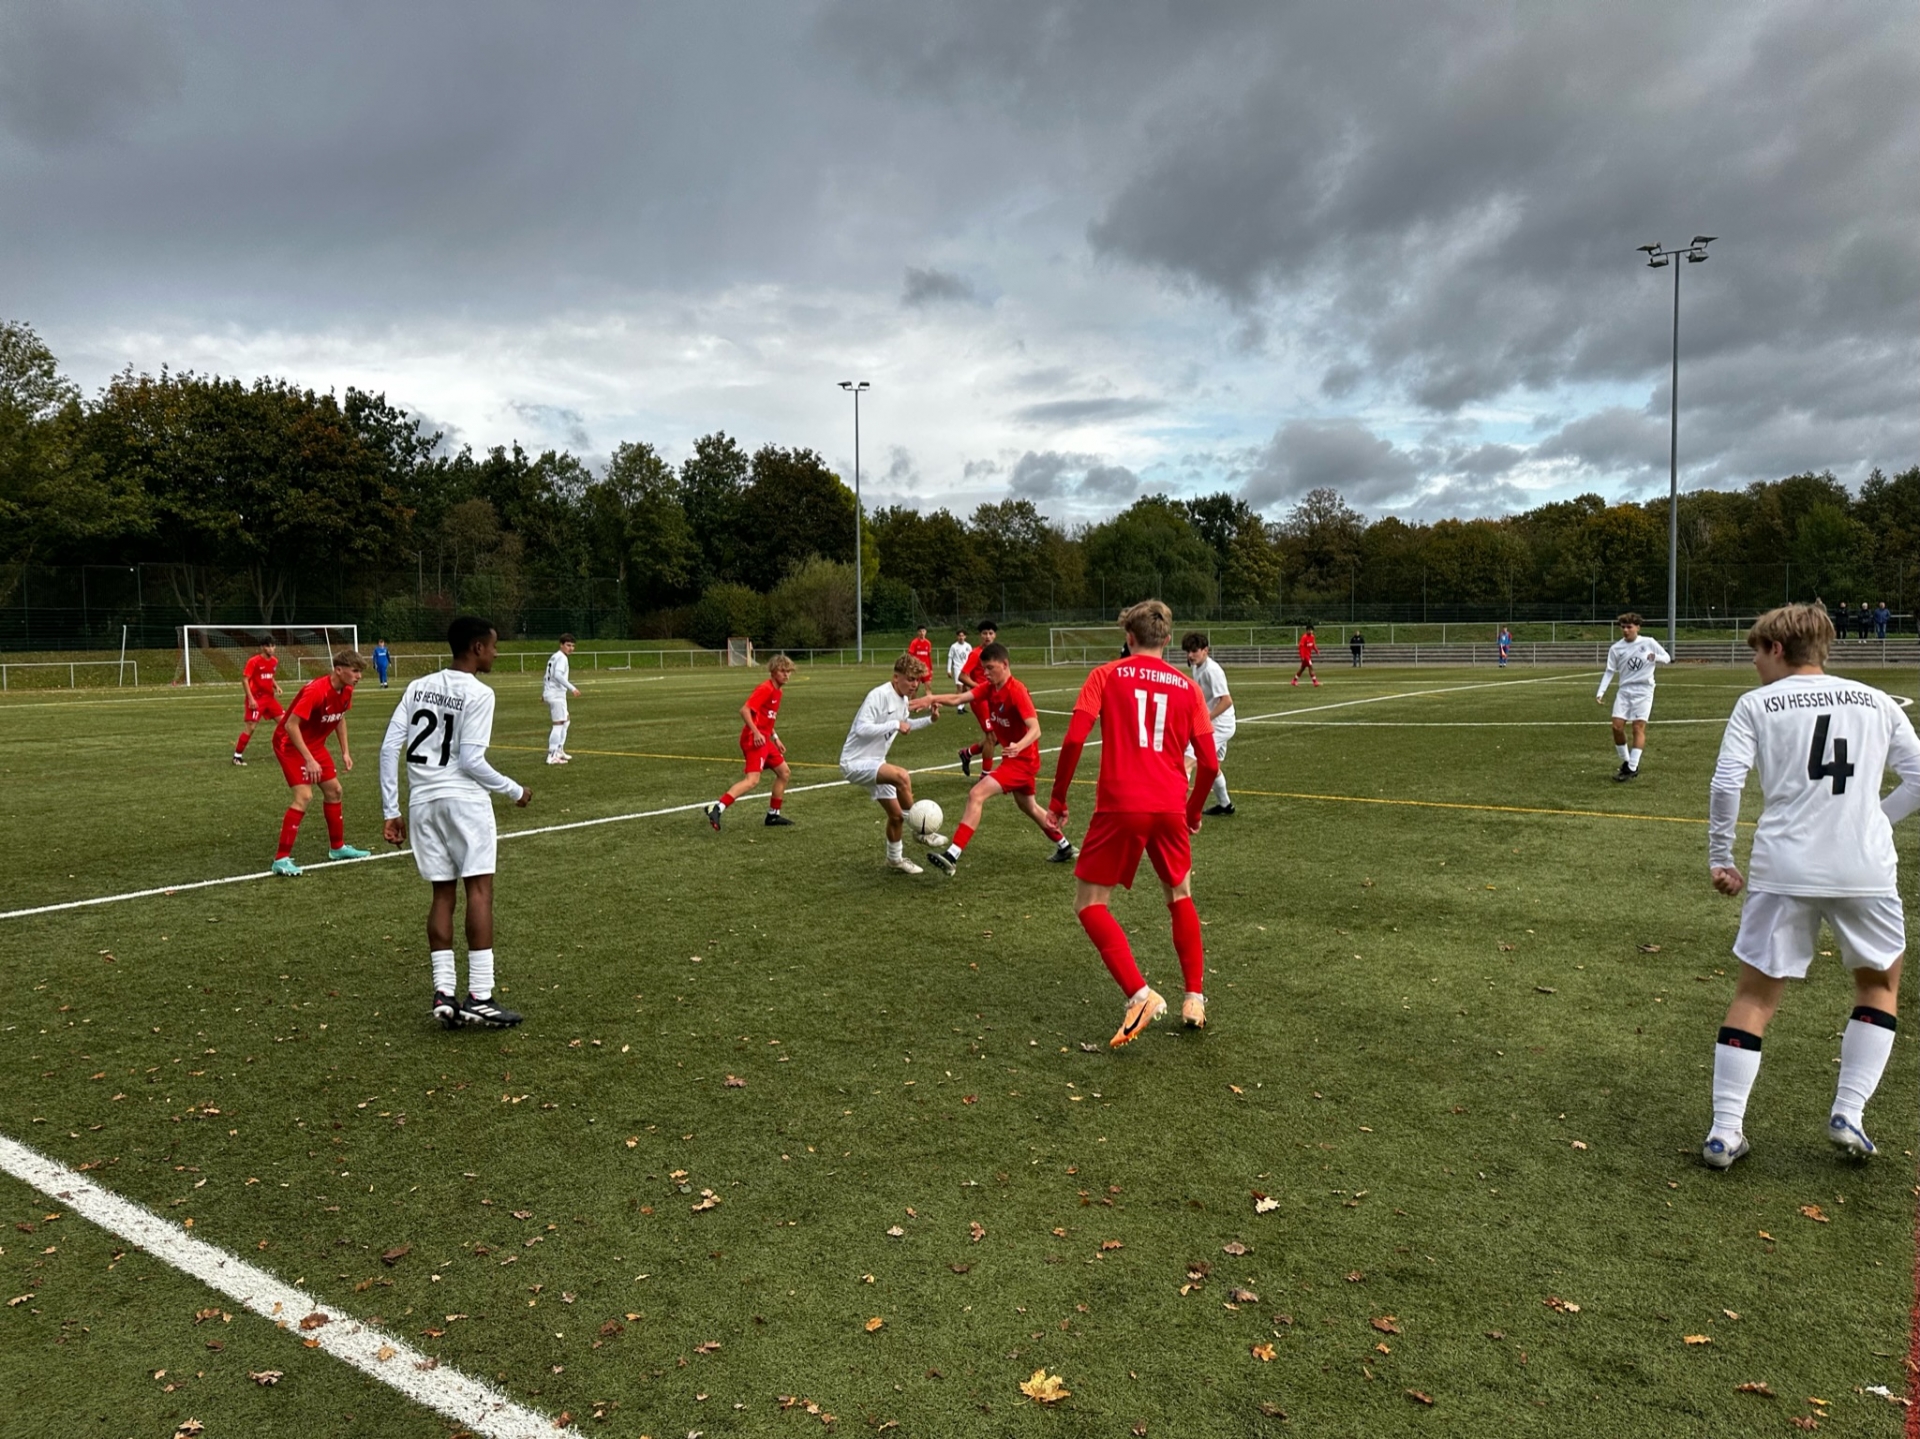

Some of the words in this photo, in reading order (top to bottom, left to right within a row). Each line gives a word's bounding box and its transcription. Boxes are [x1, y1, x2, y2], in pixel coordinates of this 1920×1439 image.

[1117, 667, 1136, 678] TSV
[1139, 668, 1189, 690] STEINBACH
[1764, 695, 1785, 713] KSV
[1787, 692, 1834, 709] HESSEN
[1835, 691, 1877, 709] KASSEL
[407, 708, 454, 767] 21
[1134, 688, 1168, 752] 11
[1807, 714, 1854, 795] 4
